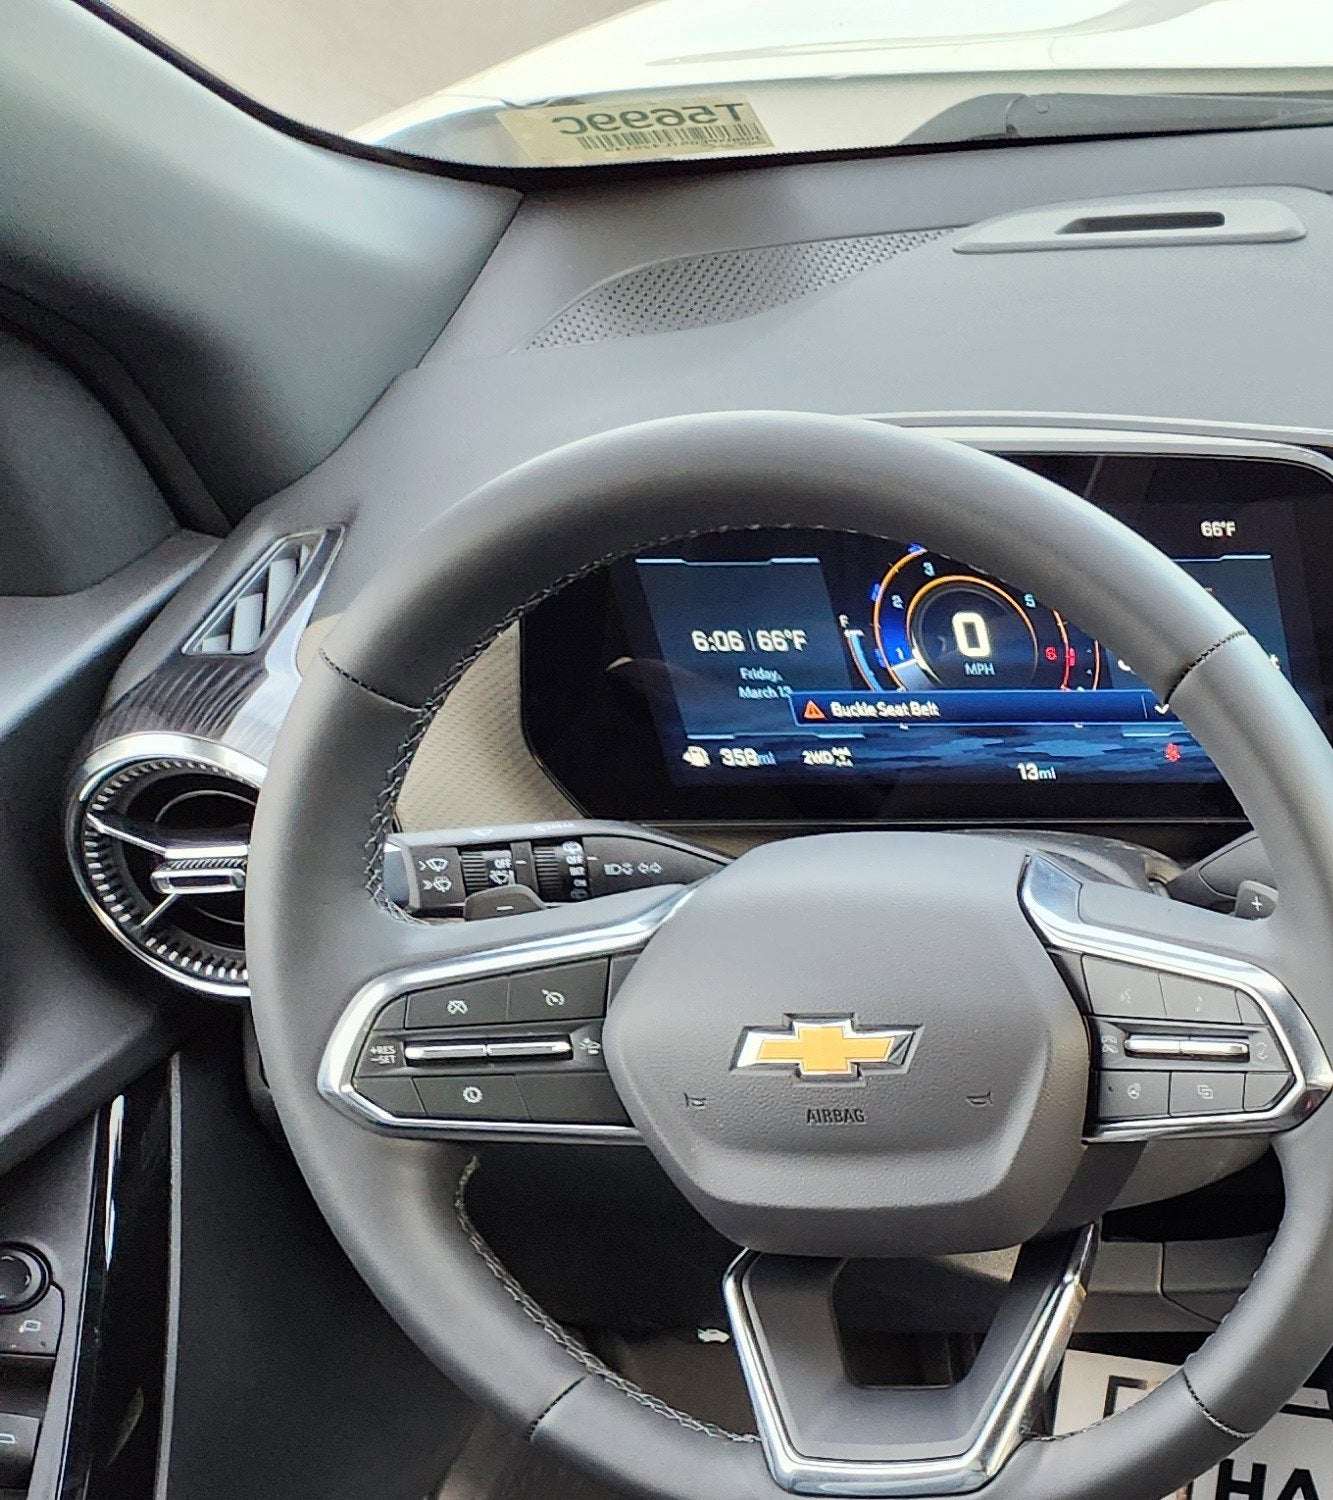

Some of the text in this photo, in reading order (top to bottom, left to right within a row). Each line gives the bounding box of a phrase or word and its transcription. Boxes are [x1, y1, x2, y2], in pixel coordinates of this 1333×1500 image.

[923, 562, 936, 576] 3
[691, 630, 744, 652] 6:06
[953, 612, 990, 657] 0
[965, 663, 995, 675] MPH
[738, 686, 777, 699] March
[830, 701, 940, 718] Buckle Seat Belt
[806, 1109, 866, 1125] AIRBAG
